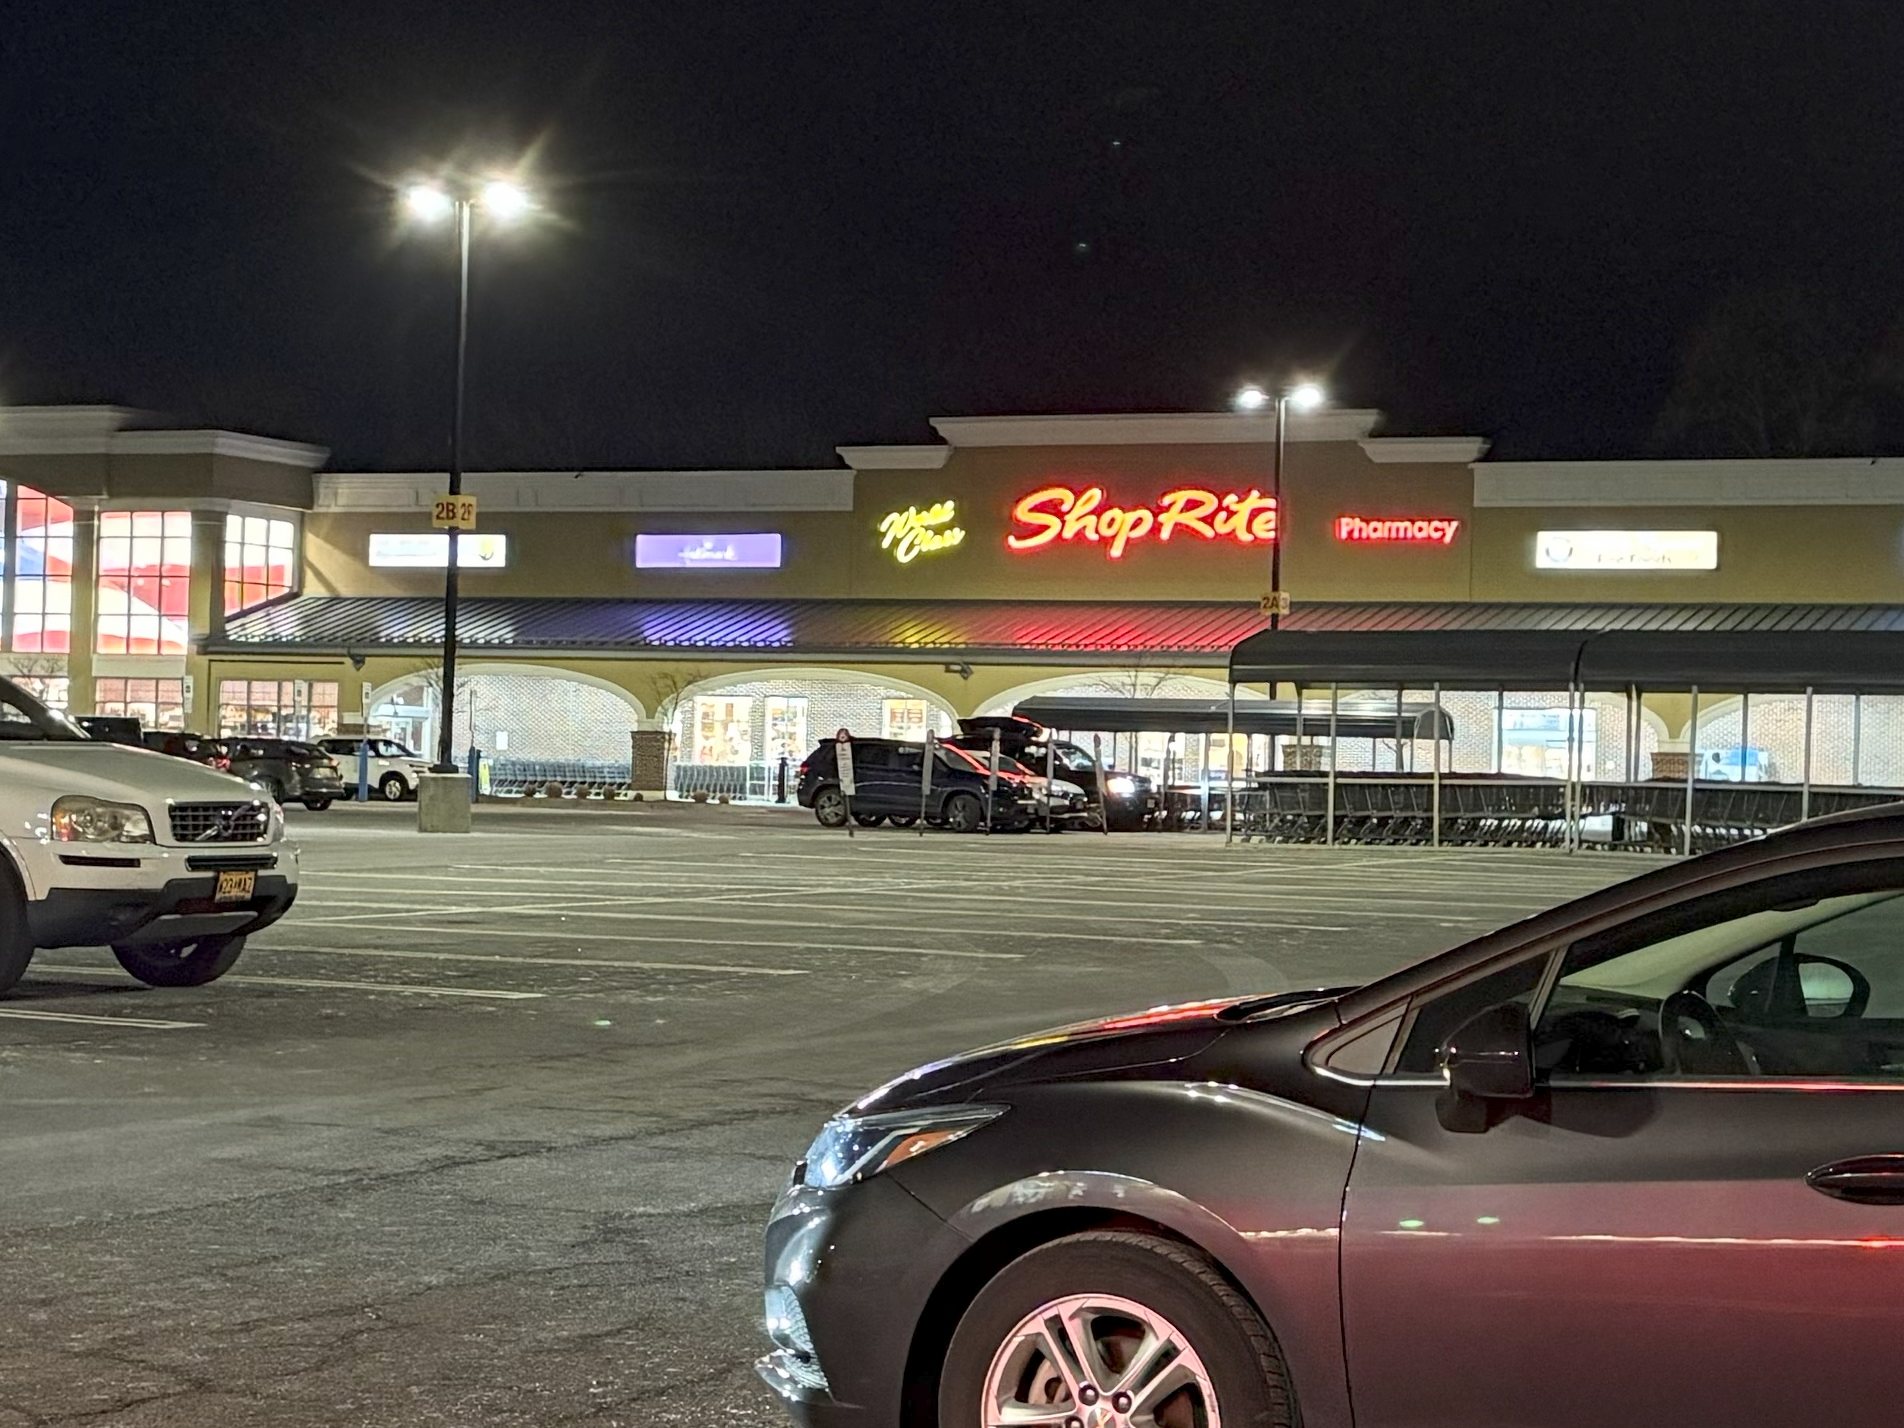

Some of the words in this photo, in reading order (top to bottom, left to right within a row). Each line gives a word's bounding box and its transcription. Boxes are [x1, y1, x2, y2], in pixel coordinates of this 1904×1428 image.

[435, 502, 456, 520] 2B
[1007, 486, 1277, 559] ShopRite
[1338, 517, 1459, 544] Pharmacy
